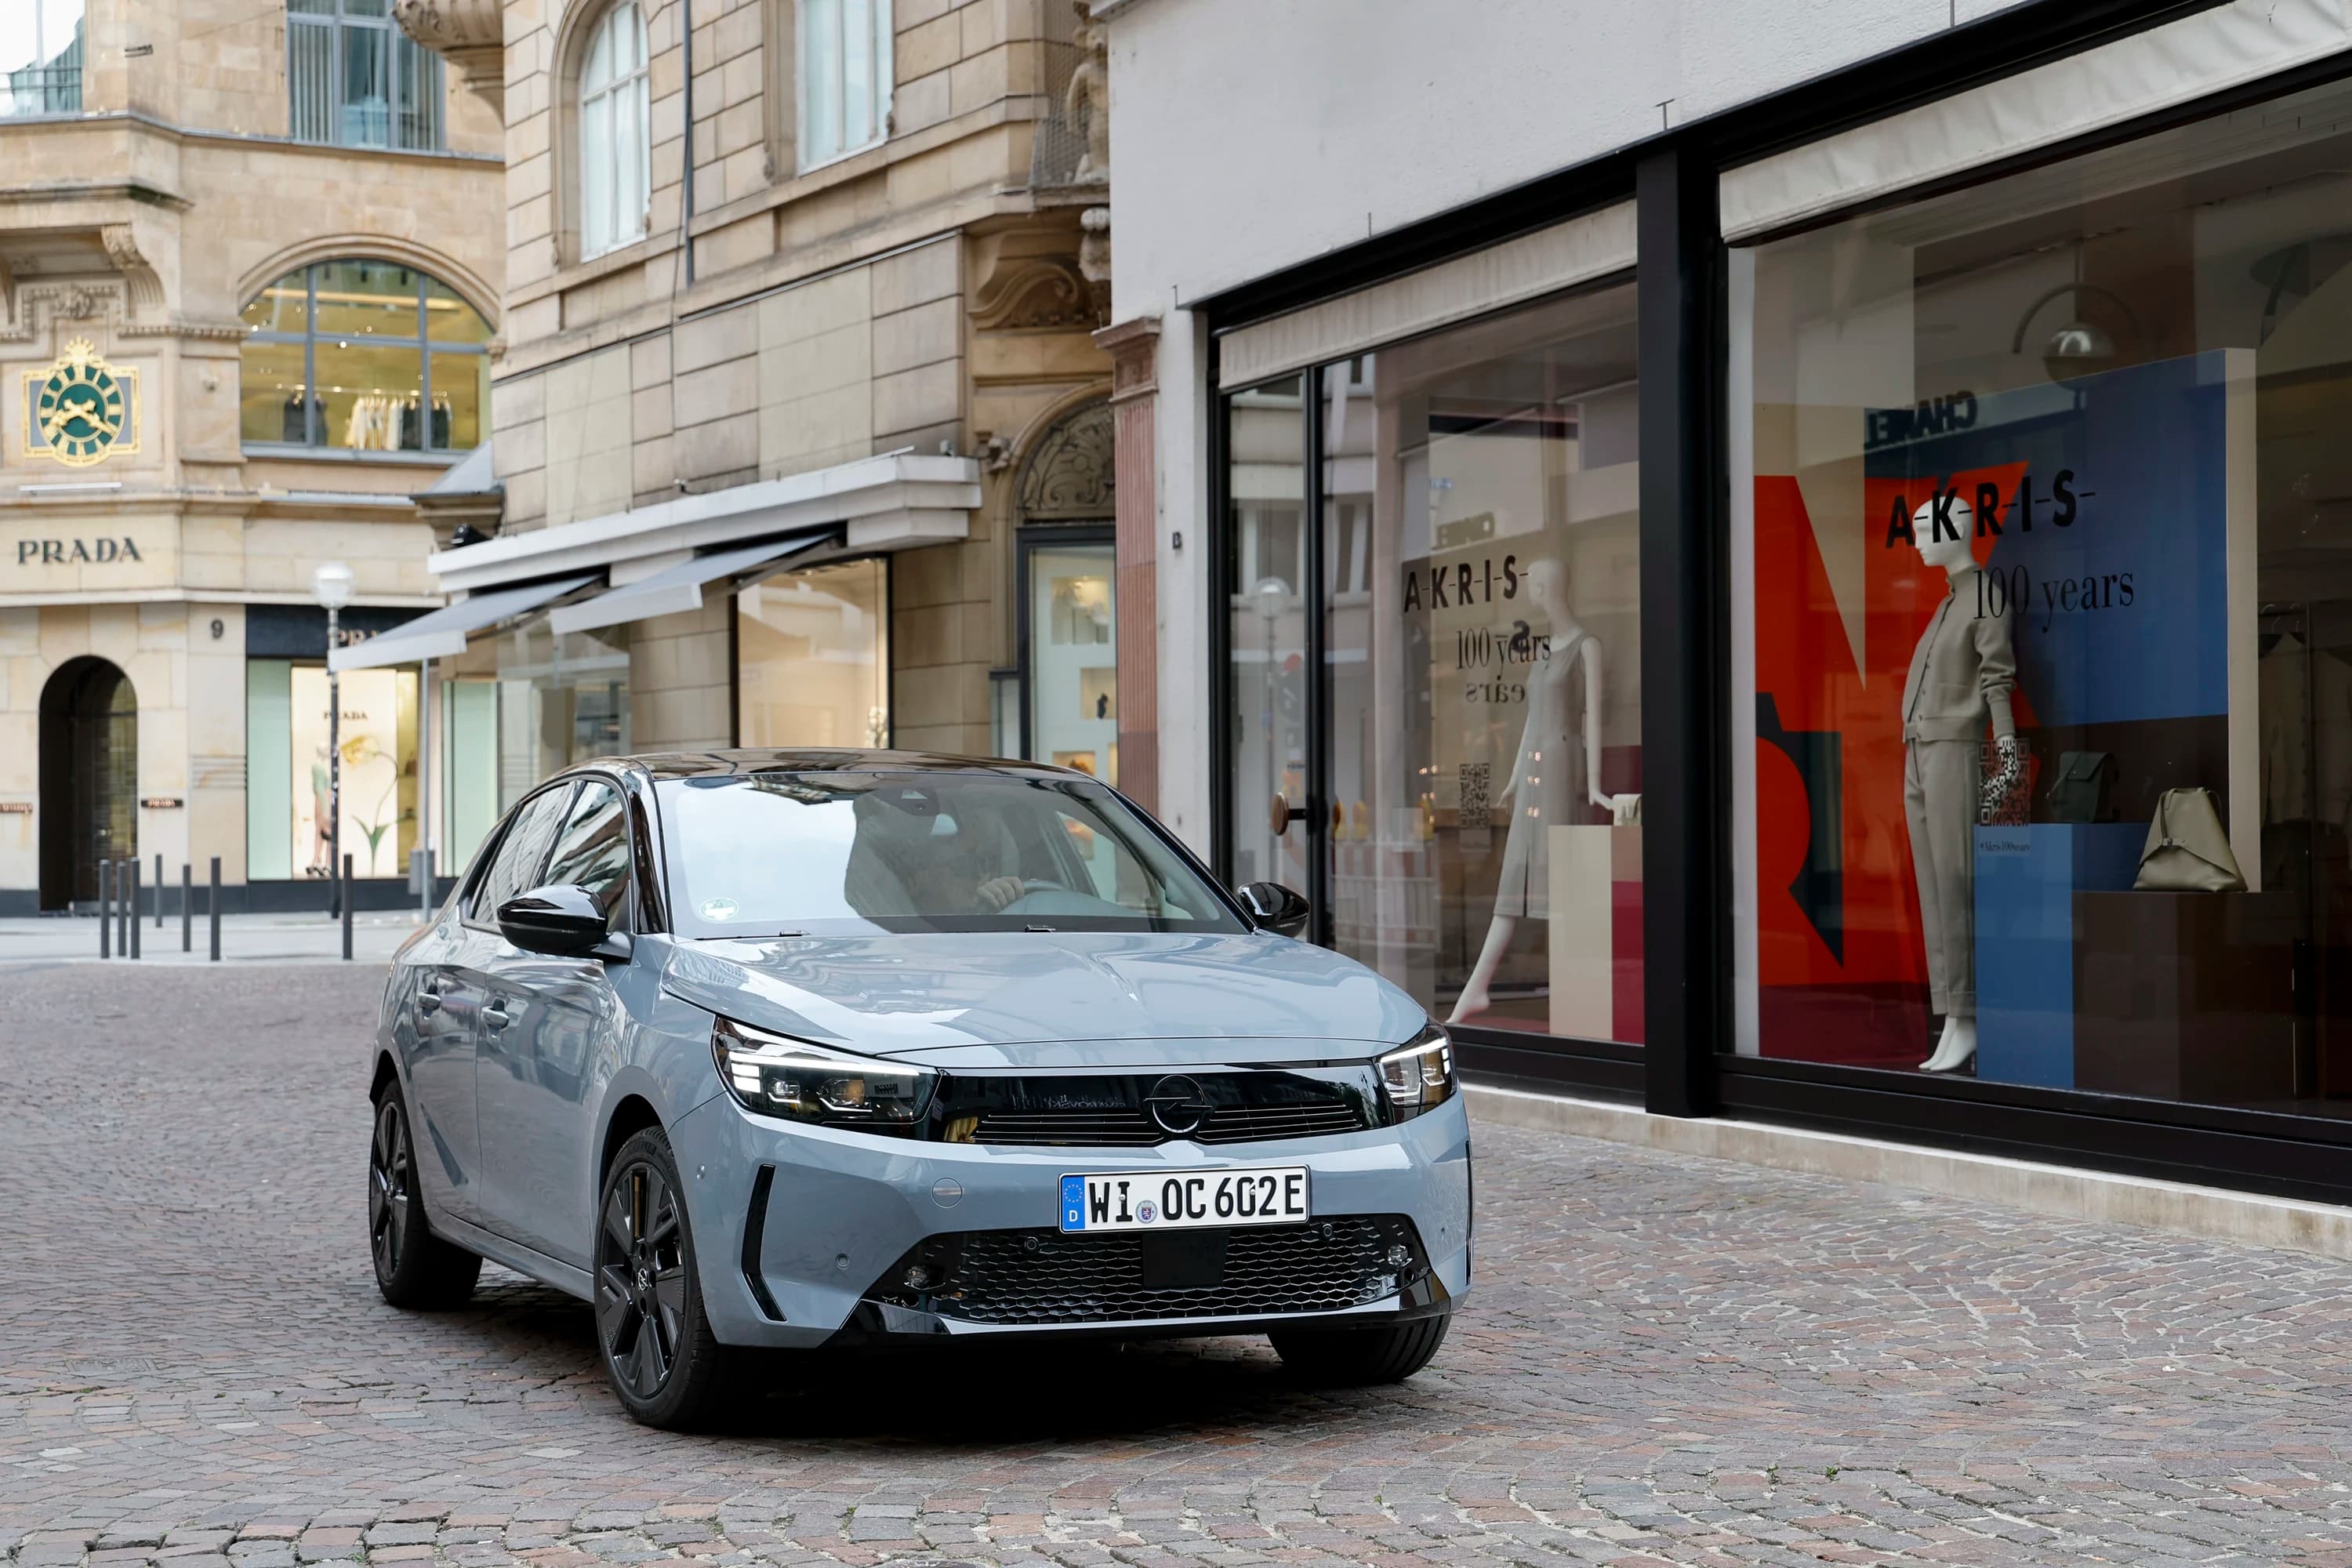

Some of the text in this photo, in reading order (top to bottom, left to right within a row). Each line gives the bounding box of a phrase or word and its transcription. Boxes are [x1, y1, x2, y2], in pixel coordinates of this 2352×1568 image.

[18, 537, 143, 565] PRADA
[1973, 564, 2135, 633] 100 years
[211, 619, 223, 640] 9
[1456, 627, 1551, 681] 100 years
[1069, 1210, 1078, 1222] D
[1089, 1181, 1133, 1223] WI
[1162, 1178, 1206, 1221] OC
